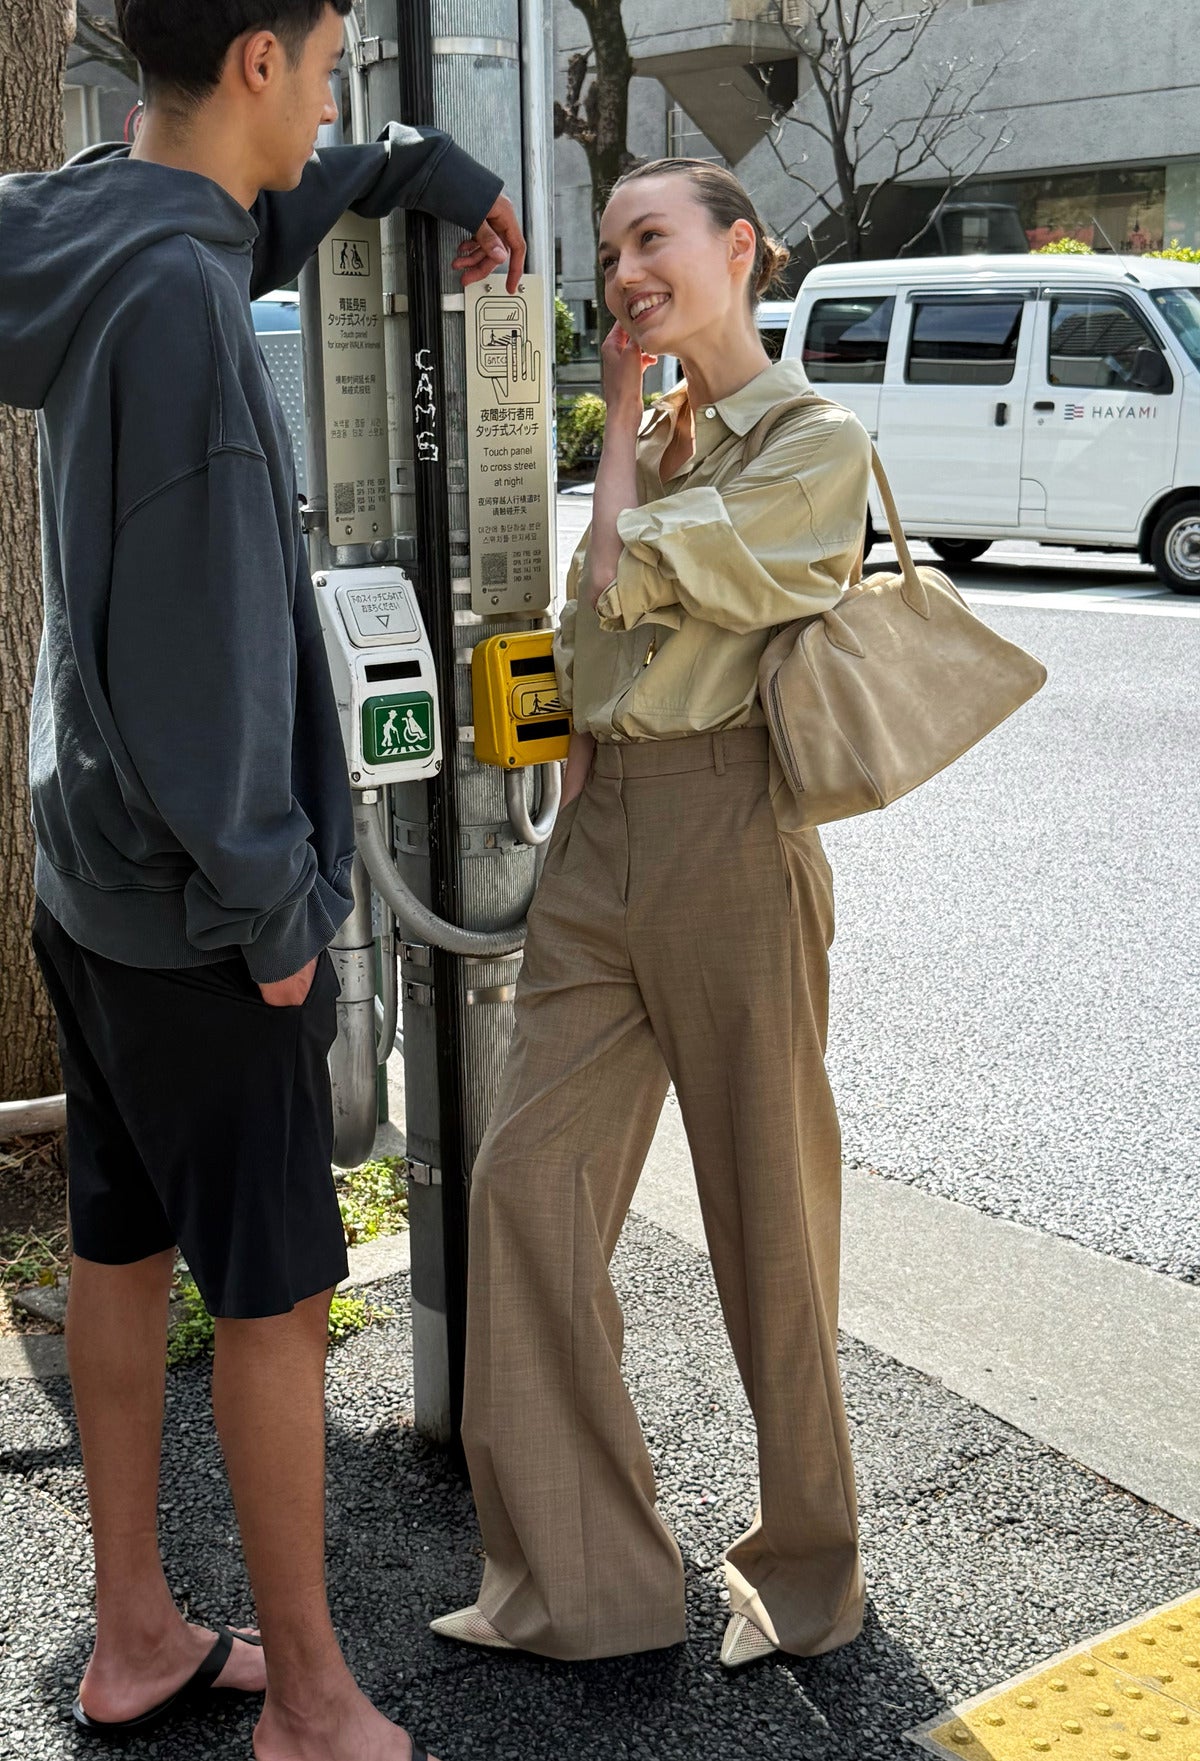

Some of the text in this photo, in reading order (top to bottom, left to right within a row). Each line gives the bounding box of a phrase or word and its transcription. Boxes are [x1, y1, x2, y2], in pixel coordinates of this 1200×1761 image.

[328, 313, 378, 327] タッチ式スイッチ
[341, 330, 367, 339] Touch panel
[480, 407, 534, 422] 夜間歩行者用
[1092, 406, 1157, 419] HAYAMI
[476, 423, 539, 438] タッチ式スイッチ
[483, 446, 533, 457] Touch panel
[480, 461, 536, 472] to cross street
[494, 477, 523, 488] at night
